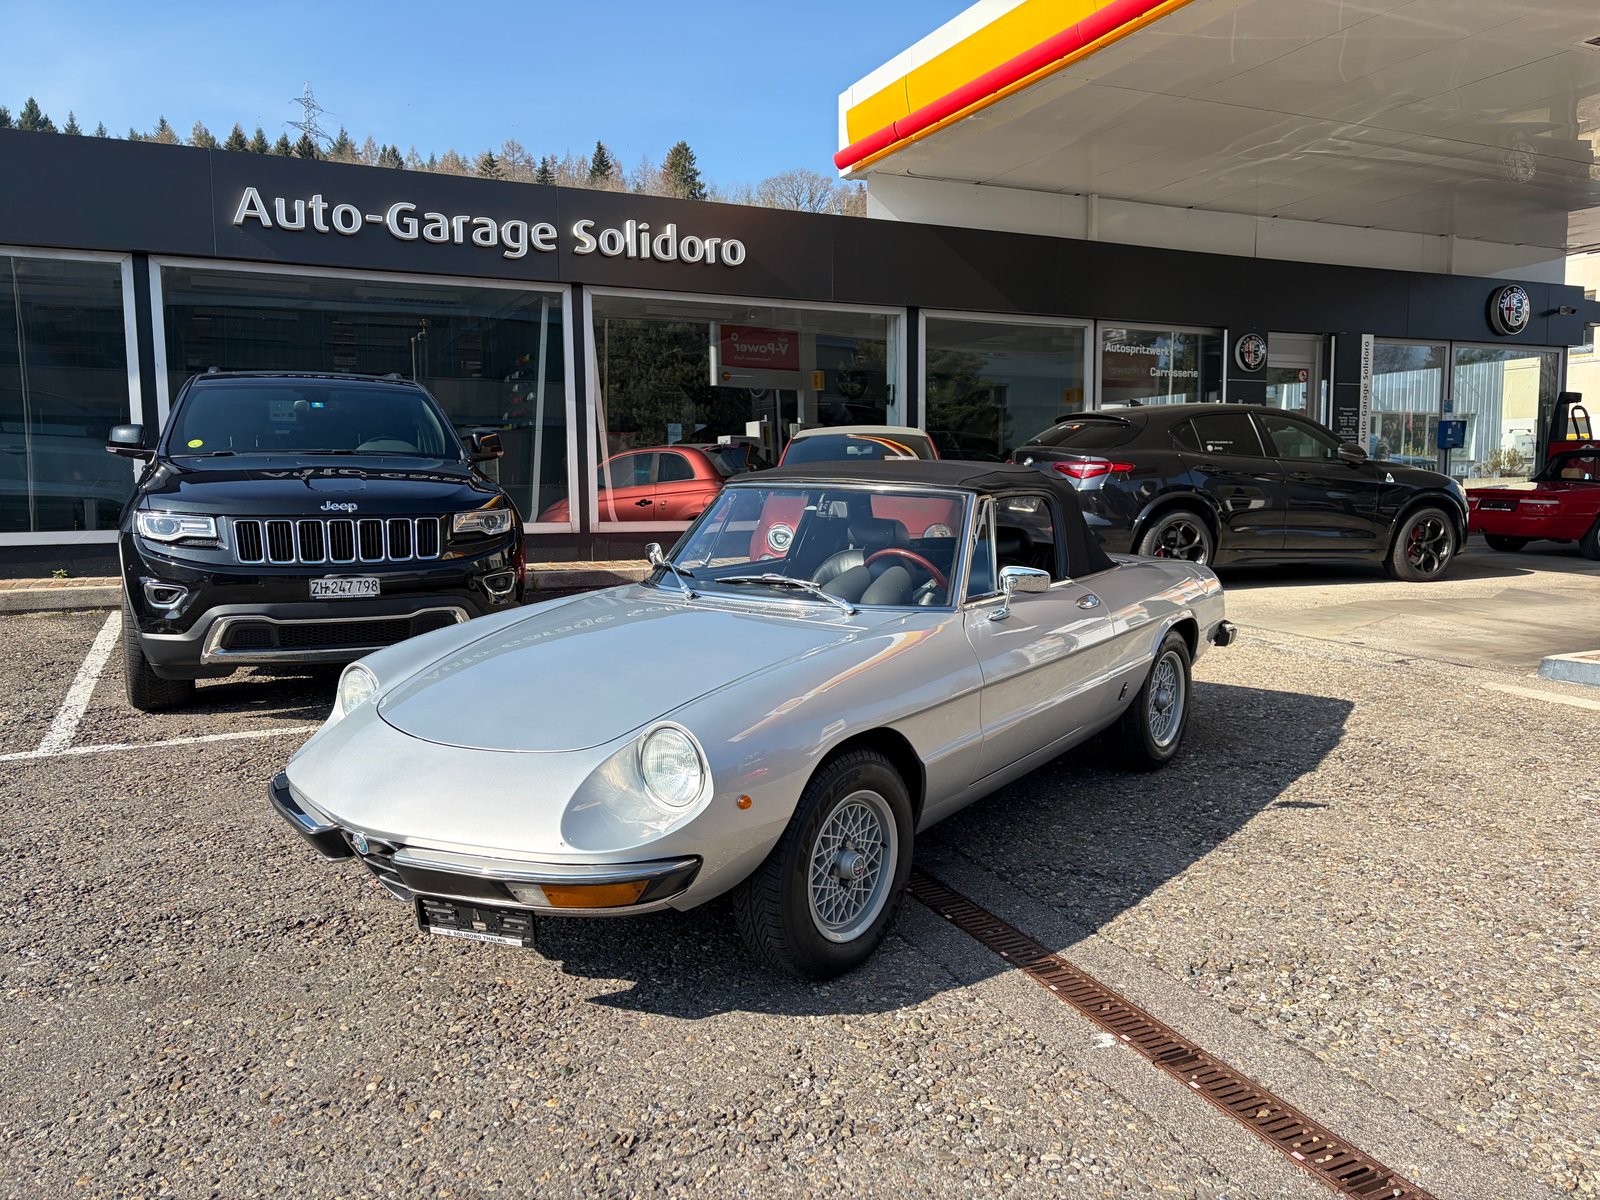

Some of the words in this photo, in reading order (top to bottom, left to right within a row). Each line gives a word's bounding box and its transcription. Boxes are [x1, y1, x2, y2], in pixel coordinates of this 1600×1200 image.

[233, 186, 558, 260] Auto-Garage
[572, 219, 747, 267] Solidoro
[1105, 342, 1170, 357] Autospritzwerk
[1362, 341, 1370, 380] Solidoro
[1150, 367, 1199, 378] Carrosserie
[1360, 383, 1370, 443] Auto-Garage
[320, 501, 358, 513] Jeep
[453, 931, 482, 941] SOLIDORO
[482, 935, 508, 944] THALWIL
